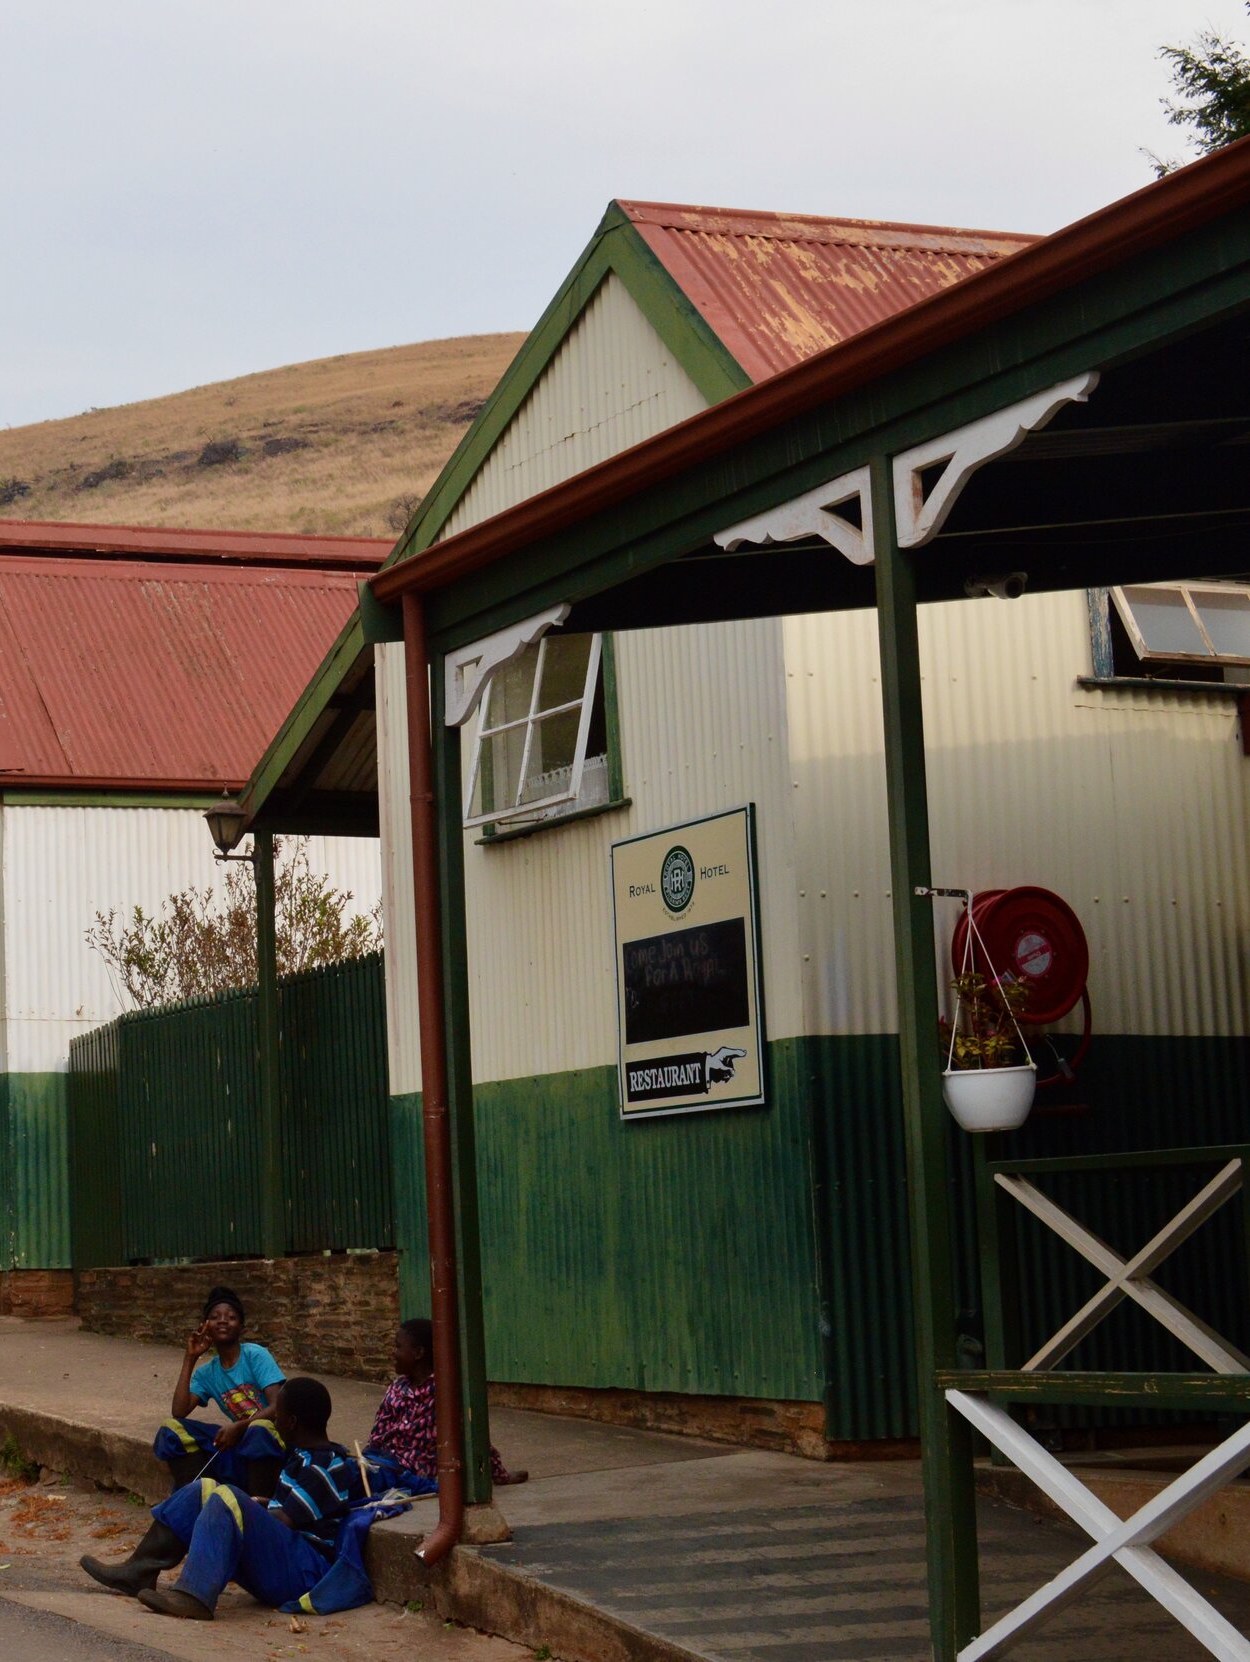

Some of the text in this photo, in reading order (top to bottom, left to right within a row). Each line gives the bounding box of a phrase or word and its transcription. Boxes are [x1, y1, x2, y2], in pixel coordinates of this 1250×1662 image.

[629, 883, 656, 898] ROYAL
[700, 864, 729, 880] HOTEL
[629, 1063, 702, 1092] RESTAURANT
